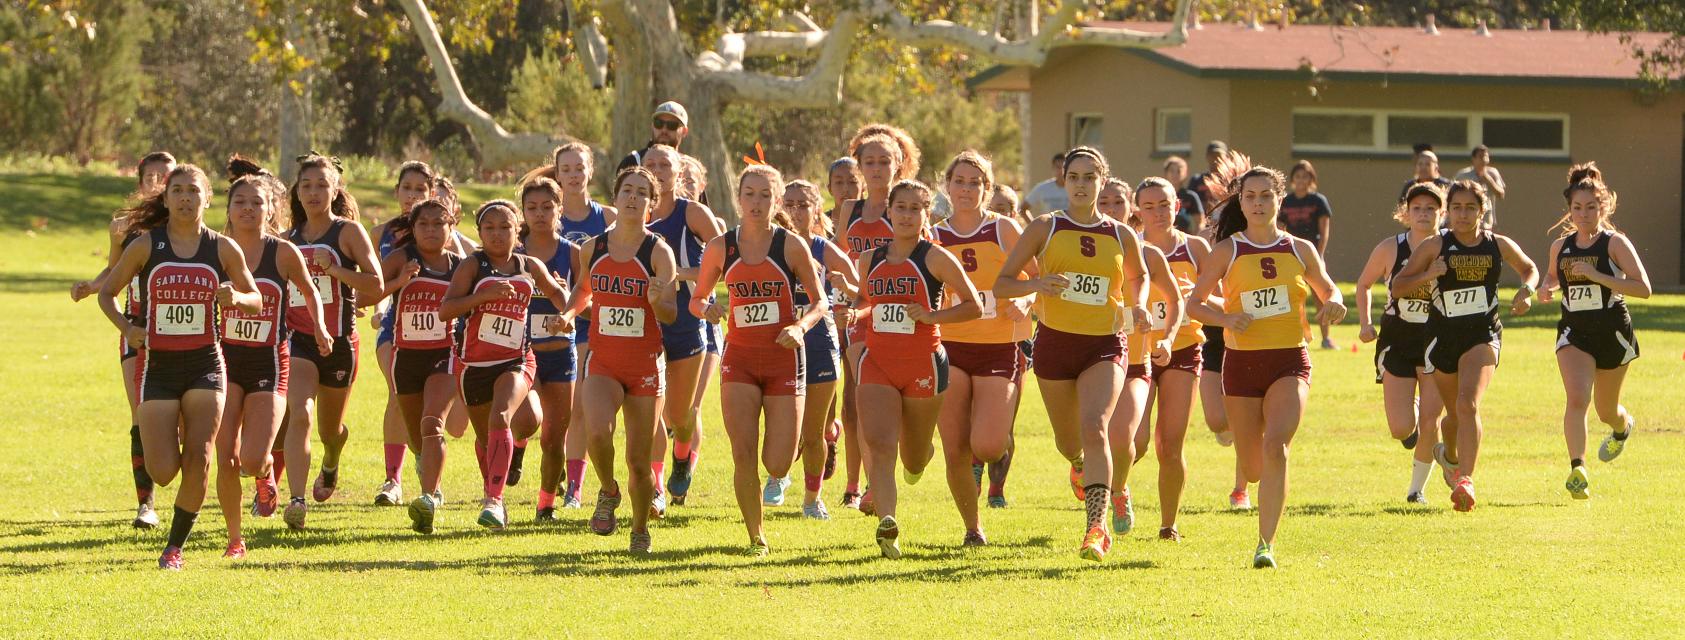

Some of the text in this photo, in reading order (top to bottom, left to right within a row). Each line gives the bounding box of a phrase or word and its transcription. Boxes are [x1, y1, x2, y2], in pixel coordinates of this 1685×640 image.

[1080, 235, 1096, 258] S
[962, 248, 977, 272] S
[1260, 257, 1278, 280] S
[1449, 254, 1493, 269] GOLDEN
[156, 274, 214, 290] SANTA ANA
[1456, 266, 1488, 281] WEST
[591, 273, 648, 298] COAST
[728, 279, 785, 298] COAST
[867, 277, 918, 298] COAST
[1073, 274, 1100, 295] 365
[1570, 287, 1592, 300] 274
[156, 289, 212, 301] COLLEGE
[405, 292, 436, 302] SANTA
[1252, 287, 1278, 309] 372
[1453, 289, 1477, 305] 277
[165, 304, 195, 325] 409
[223, 306, 275, 320] COLLGE
[478, 302, 525, 314] COLLEGE
[743, 303, 769, 324] 322
[881, 304, 905, 323] 316
[1407, 300, 1430, 313] 278
[411, 312, 435, 331] 410
[608, 307, 634, 327] 326
[234, 320, 262, 340] 407
[491, 316, 514, 338] 411
